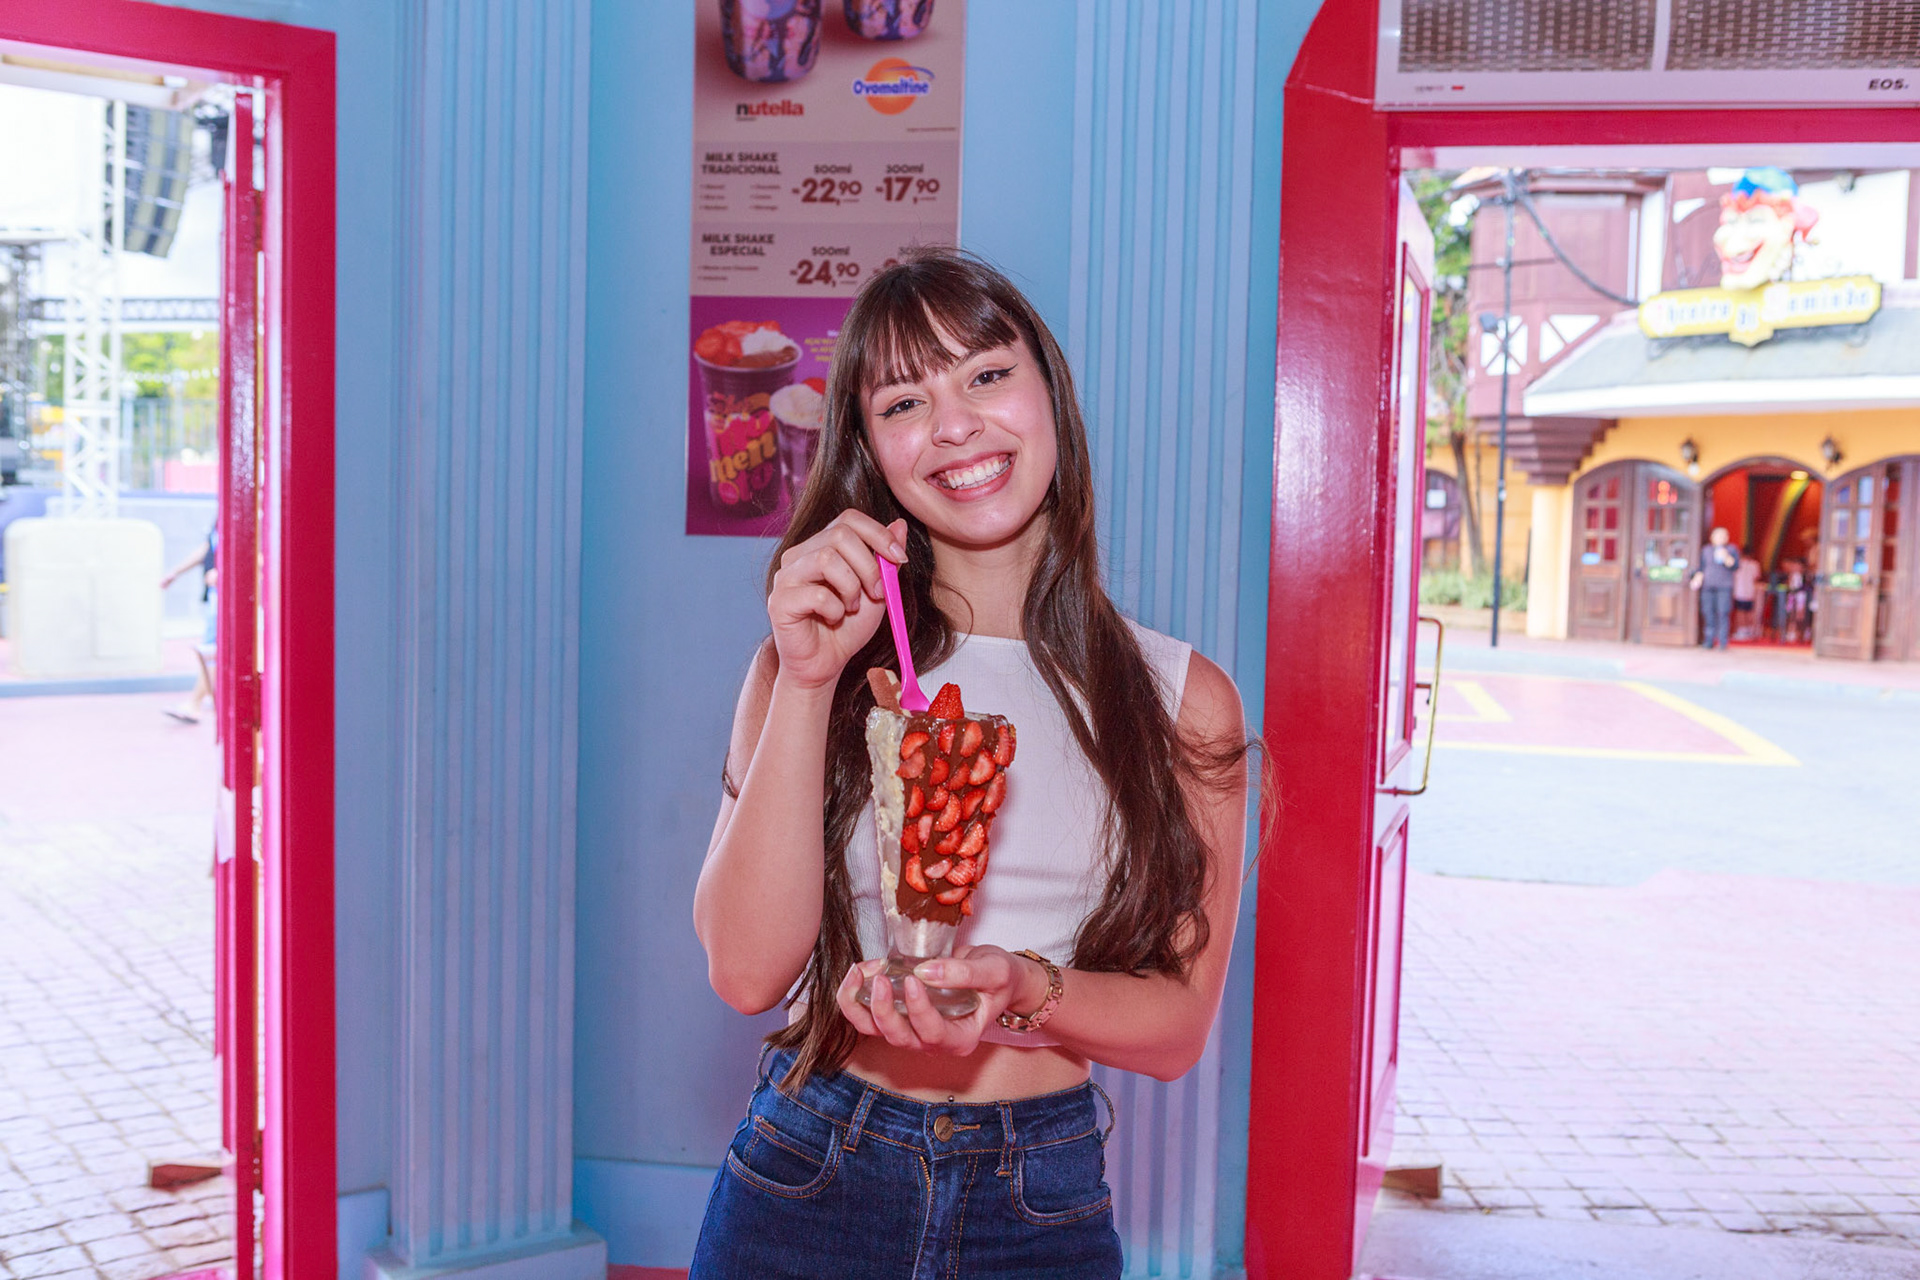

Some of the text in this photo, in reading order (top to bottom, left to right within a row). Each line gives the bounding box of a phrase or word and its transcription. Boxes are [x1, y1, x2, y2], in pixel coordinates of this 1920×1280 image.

[853, 77, 929, 95] Ovomaltine
[736, 99, 804, 116] nutella
[705, 152, 778, 162] MILK SHAKE
[702, 164, 781, 175] TRADICIONAL
[814, 164, 852, 174] 500ml
[886, 163, 924, 174] 300ml
[702, 233, 775, 244] MILK SHAKE
[710, 245, 766, 256] ESPECIAL
[812, 246, 850, 256] 500ml
